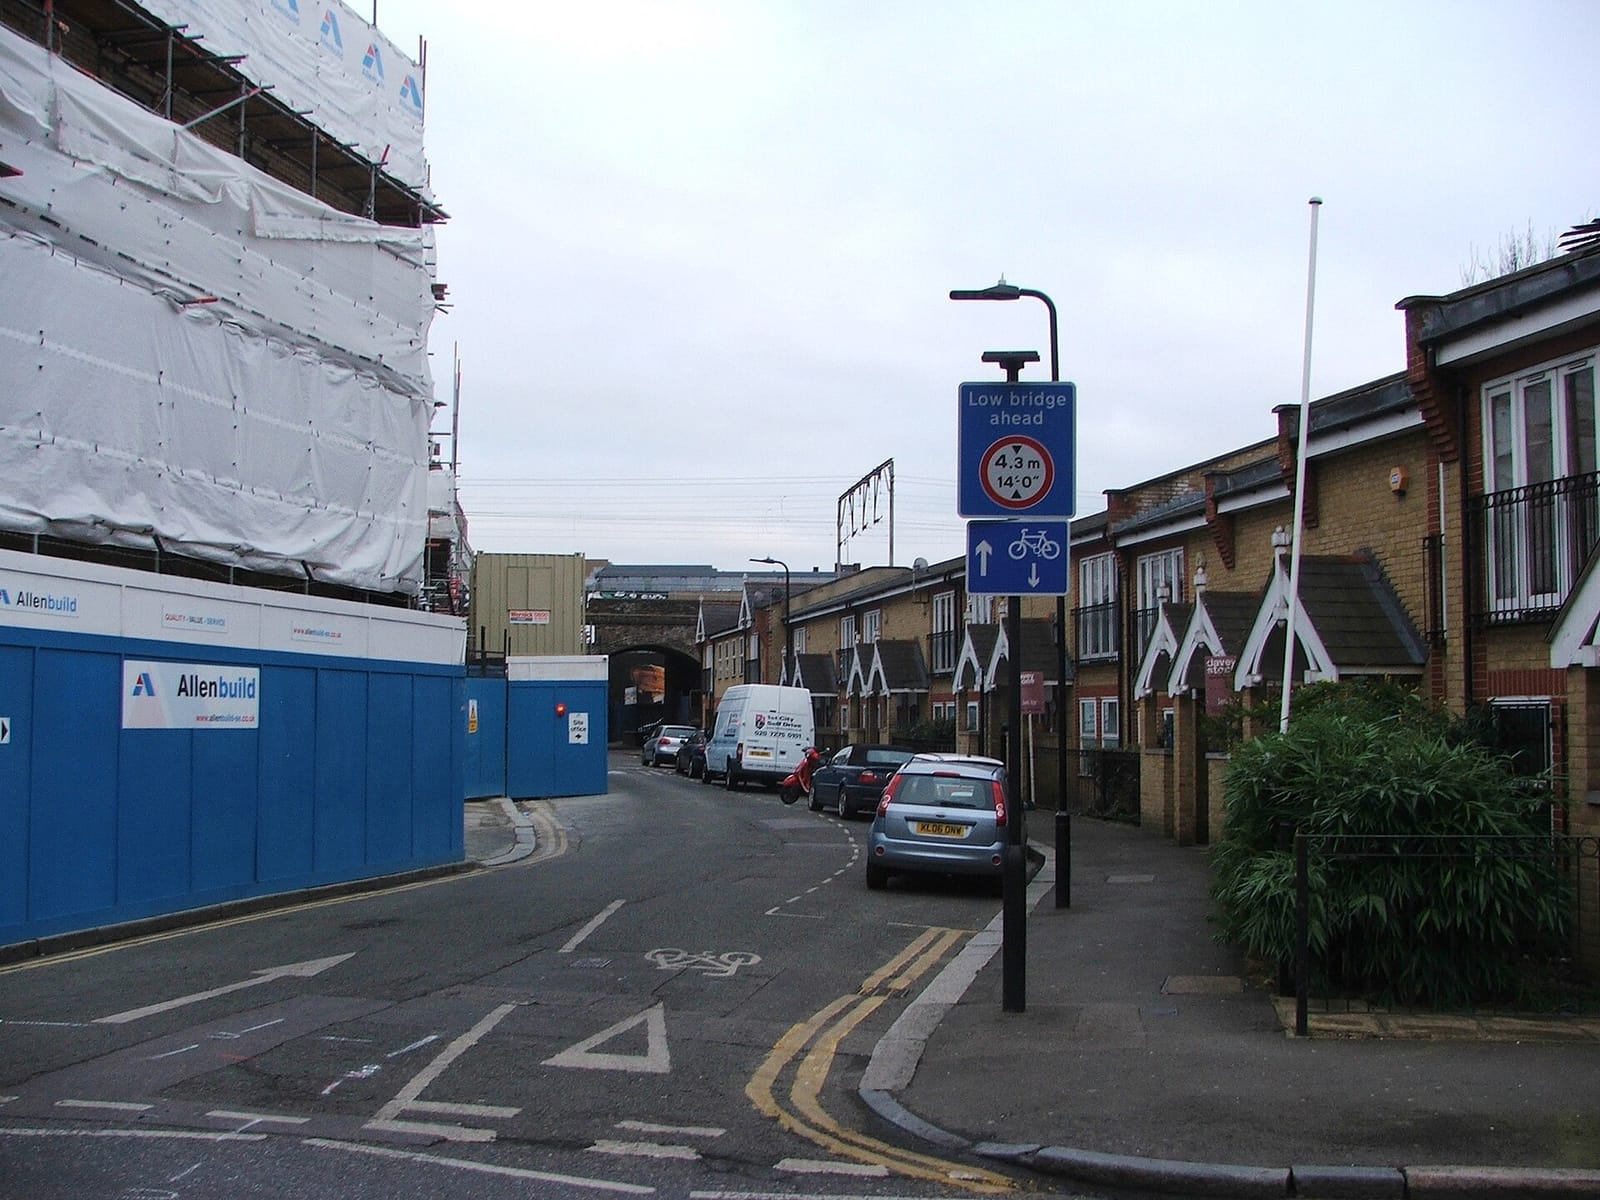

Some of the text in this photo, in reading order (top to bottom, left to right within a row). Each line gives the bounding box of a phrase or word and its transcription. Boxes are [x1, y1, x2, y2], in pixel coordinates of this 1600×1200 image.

[968, 391, 1067, 410] Low bridge
[989, 410, 1044, 426] ahead
[994, 453, 1024, 470] 4.3
[16, 591, 77, 612] Allenbuild
[1206, 658, 1236, 671] davey
[177, 673, 256, 699] Allenbuild
[920, 823, 943, 833] KL06
